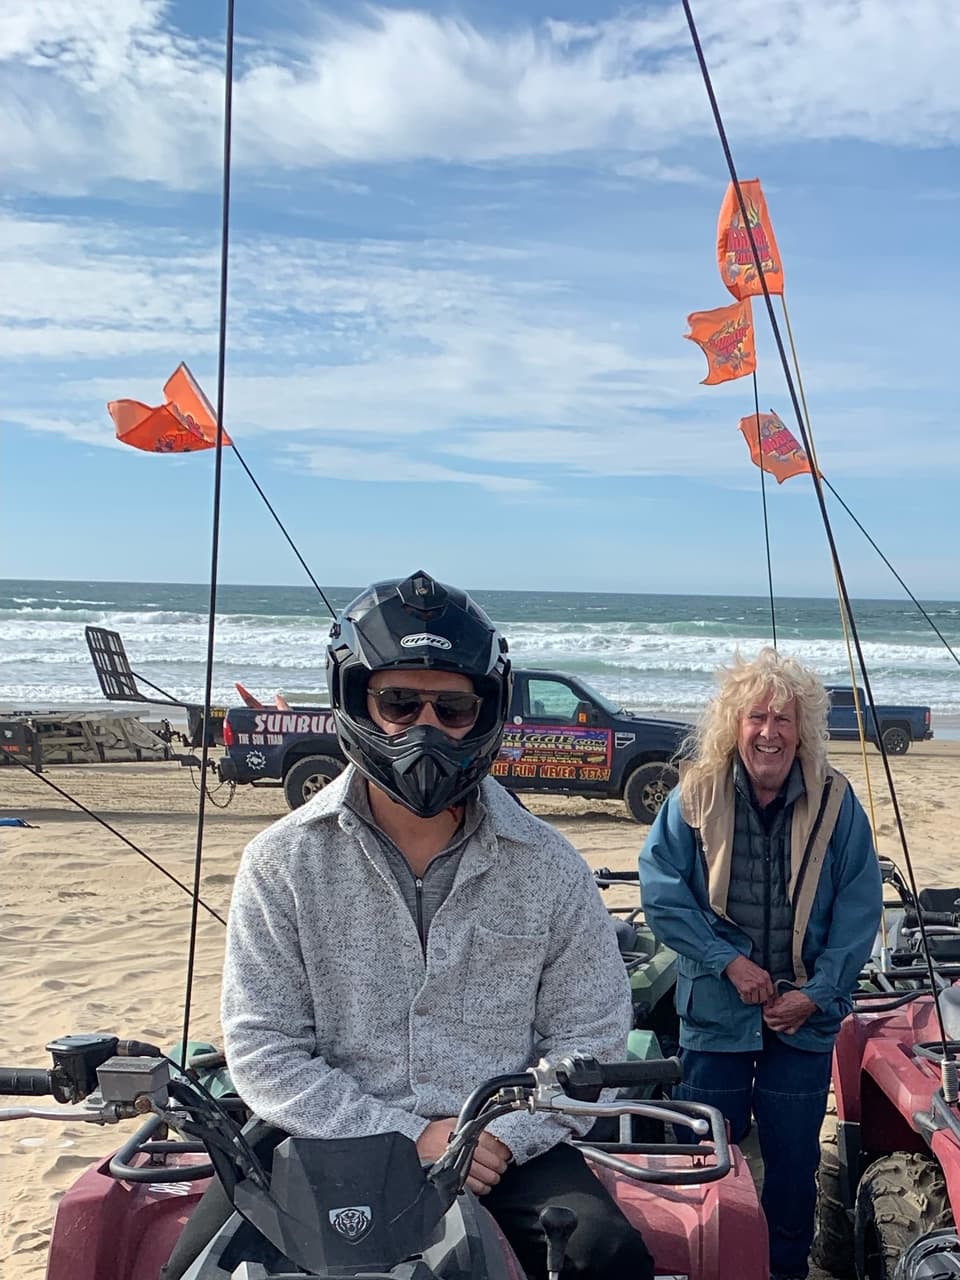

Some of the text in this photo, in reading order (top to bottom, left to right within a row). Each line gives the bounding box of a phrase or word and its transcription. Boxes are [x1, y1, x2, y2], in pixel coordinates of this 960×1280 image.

[491, 762, 509, 777] HE
[511, 763, 537, 778] FUN
[540, 764, 576, 779] NEVER
